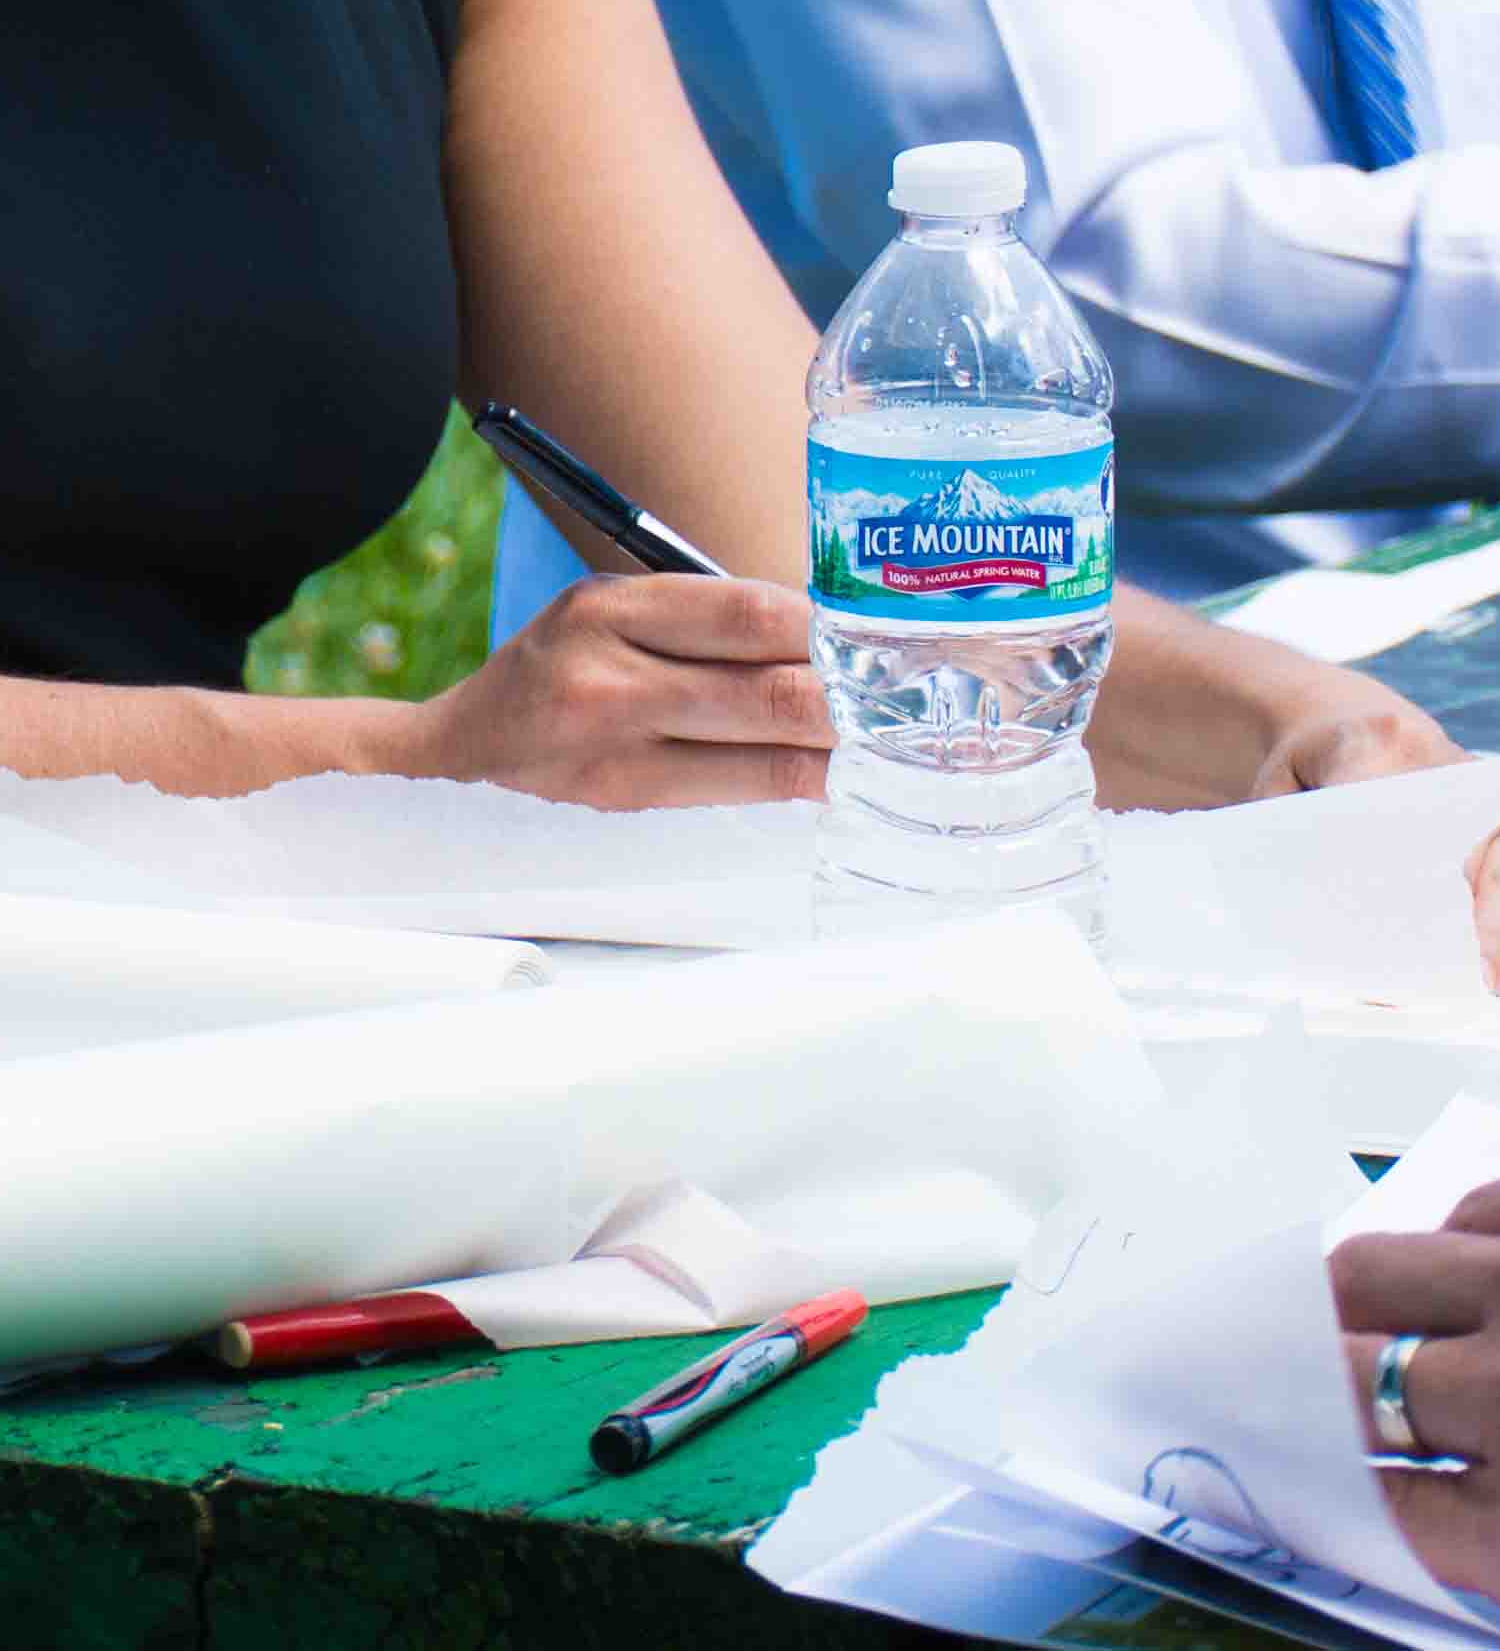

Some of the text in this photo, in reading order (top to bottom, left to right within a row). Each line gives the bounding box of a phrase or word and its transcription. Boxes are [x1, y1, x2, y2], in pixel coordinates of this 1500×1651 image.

[988, 469, 1037, 479] QUALITY
[864, 524, 1064, 557] ICE MOUNTAIN
[888, 566, 1041, 586] 100% NATURAL SPRING WATER
